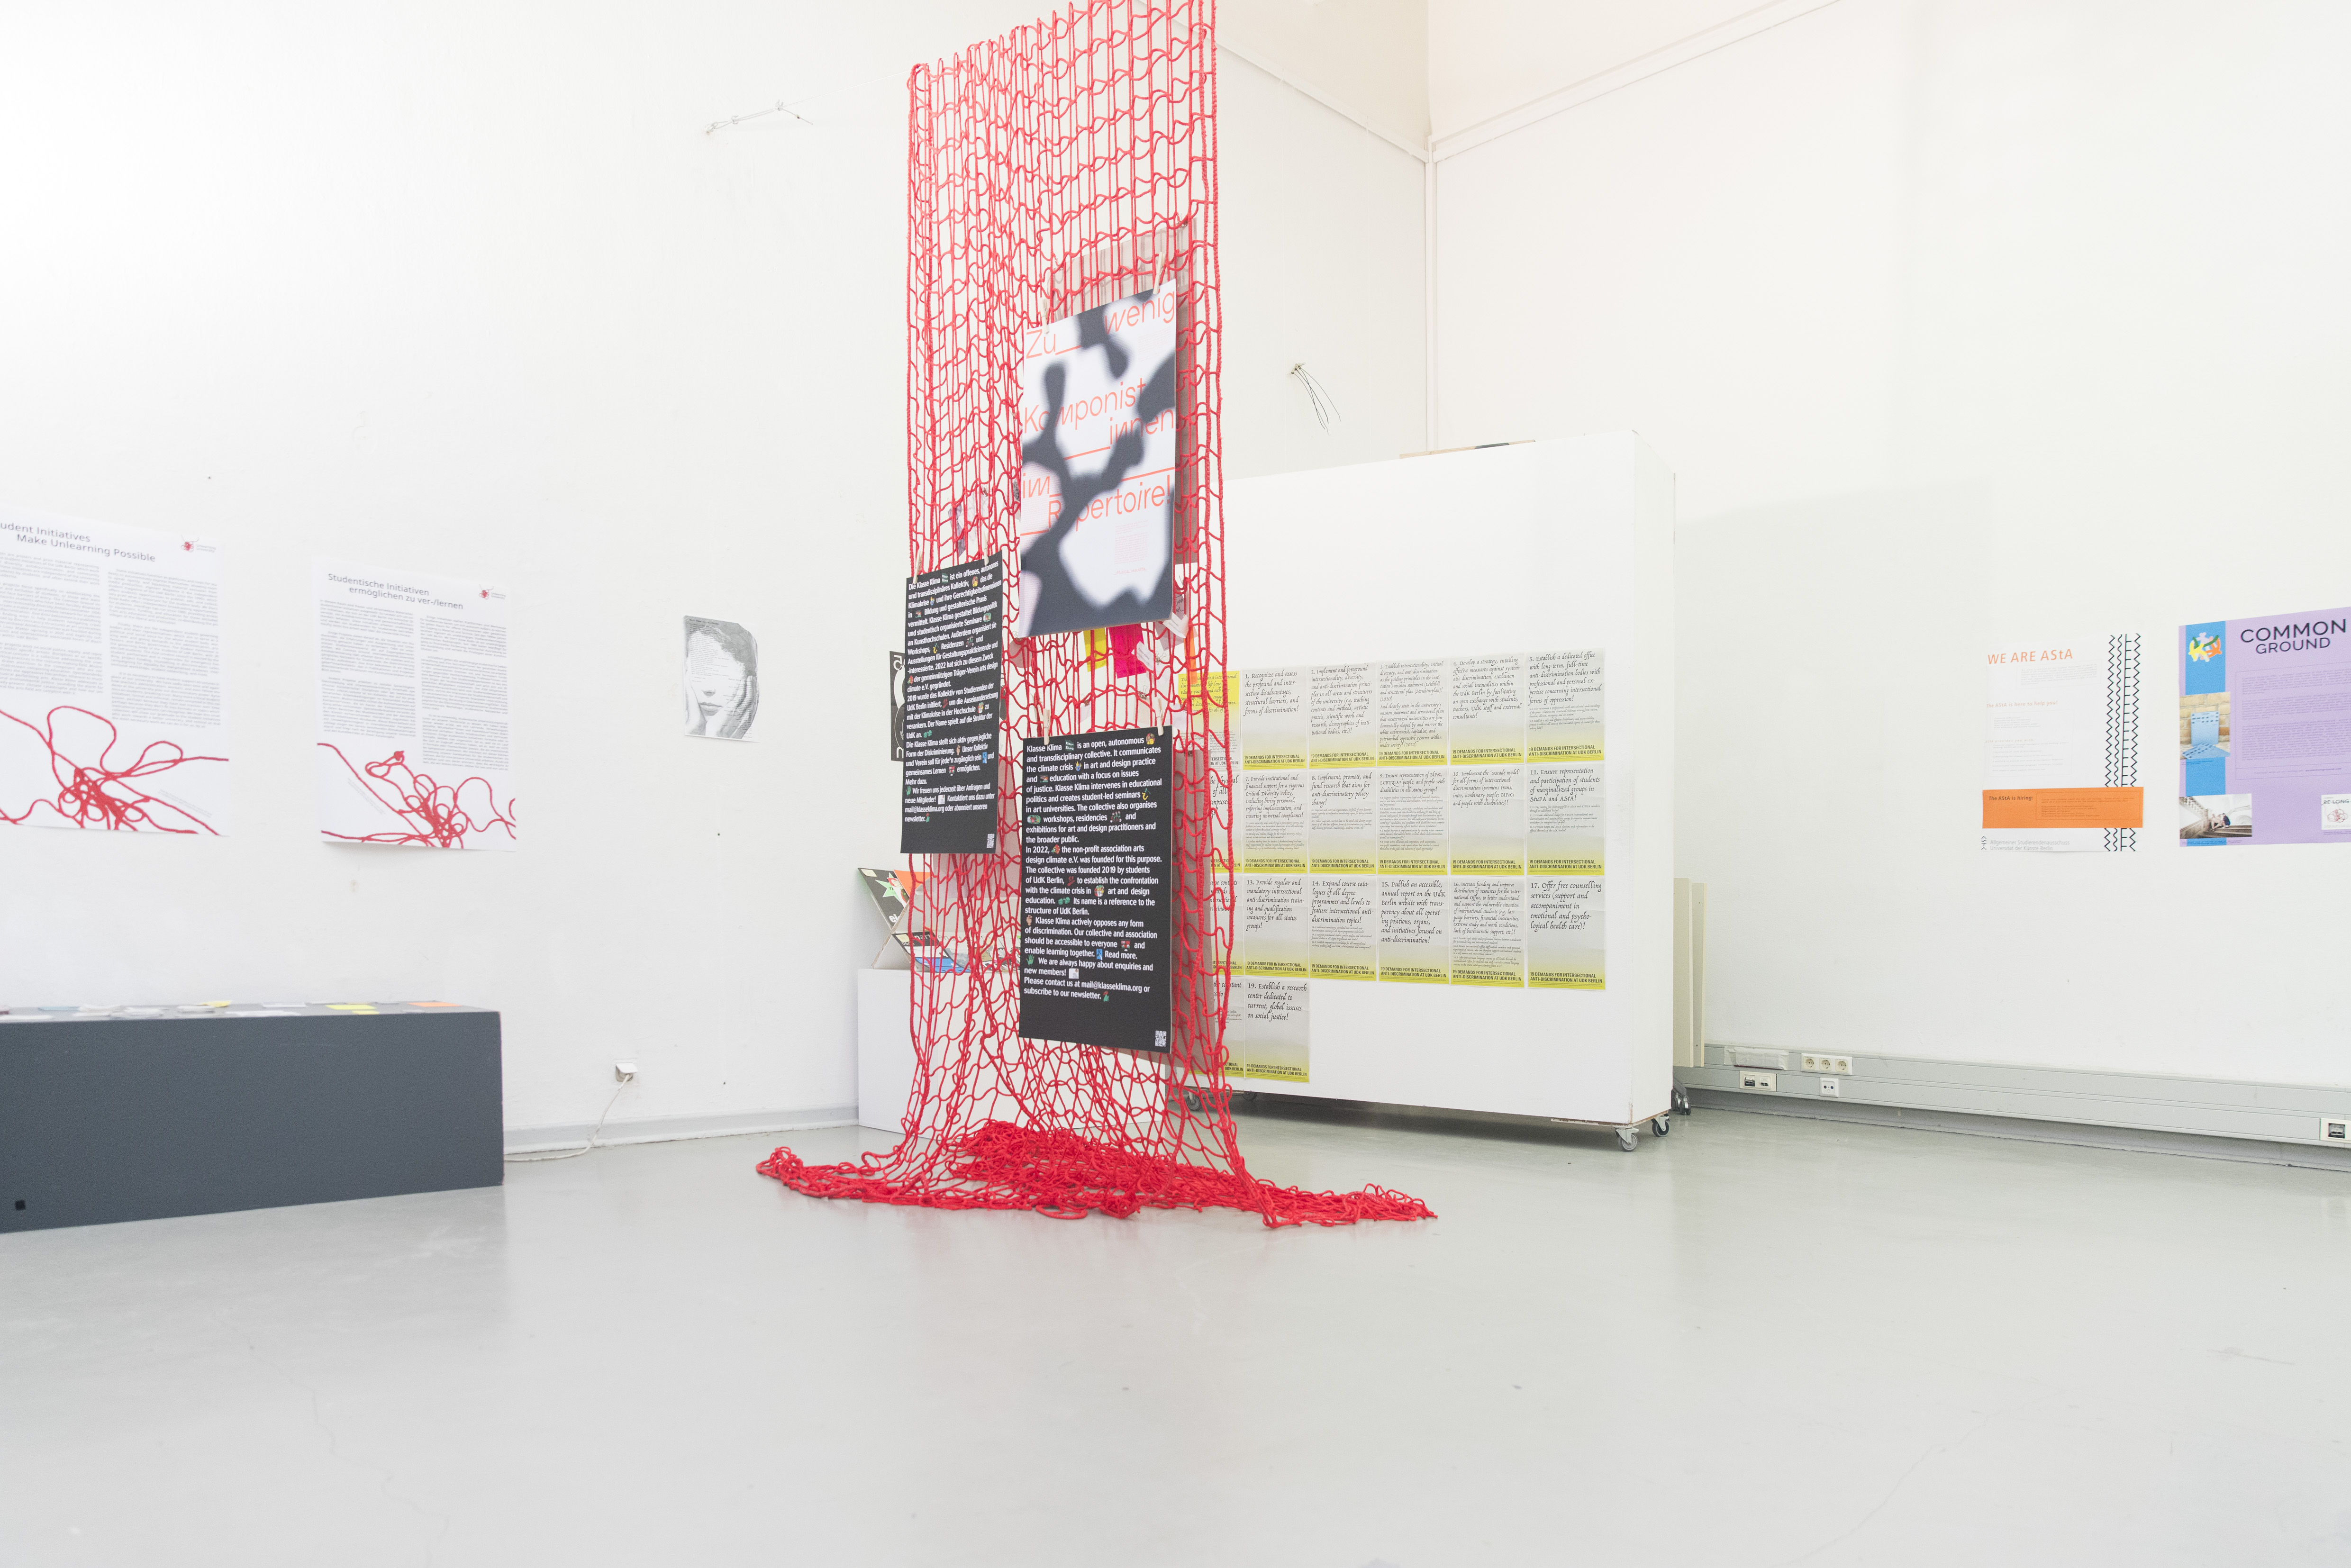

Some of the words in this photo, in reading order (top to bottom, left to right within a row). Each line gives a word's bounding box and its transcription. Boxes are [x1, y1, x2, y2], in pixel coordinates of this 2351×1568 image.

[1105, 290, 1175, 335] wenig
[1048, 474, 1171, 532] Rpertoire!
[0, 523, 33, 533] udent
[37, 527, 90, 542] Initiatives
[17, 534, 47, 545] Make
[51, 539, 110, 556] Unlearning
[114, 549, 155, 562] Possible
[963, 569, 980, 577] offenes,
[981, 561, 998, 572] autonomes
[328, 574, 384, 589] Studentische
[387, 583, 429, 595] Initiativen
[349, 588, 403, 599] ermöglichen
[418, 598, 463, 609] ver-/lernen
[2241, 618, 2347, 643] COMMON
[2256, 637, 2331, 654] GROUND
[1988, 653, 2006, 664] WE
[2011, 651, 2036, 662] ARE
[2041, 649, 2072, 661] AStA
[1252, 672, 1273, 681] Recognize
[1253, 679, 1273, 690] profound
[1245, 690, 1259, 698] secting
[1261, 688, 1291, 697] disadvantages,
[1243, 707, 1257, 716] forms
[1259, 707, 1264, 715] of
[1264, 705, 1299, 713] discrimination!
[1108, 738, 1144, 746] autonomous
[1039, 753, 1083, 761] transdisciplinary
[1084, 750, 1112, 759] collective.
[1119, 747, 1161, 756] communicates
[1112, 759, 1131, 768] design
[1132, 758, 1156, 767] practice
[1033, 846, 1050, 854] 2022,
[1072, 845, 1099, 854] non-profit
[1026, 856, 1044, 864] design
[1542, 880, 1556, 891] Offer
[1557, 880, 1569, 891] free
[1570, 880, 1601, 892] counselling
[1552, 892, 1575, 902] (support
[1531, 903, 1572, 912] accompaniment
[1571, 911, 1591, 922] psycho-
[1531, 921, 1549, 933] logical
[1550, 921, 1567, 929] health
[1569, 922, 1585, 930] care)!
[1024, 977, 1044, 985] Please
[1081, 981, 1142, 993] mail@klasseklima.org
[1287, 983, 1307, 991] research
[1269, 1002, 1285, 1012] global
[1269, 1012, 1289, 1022] justice!
